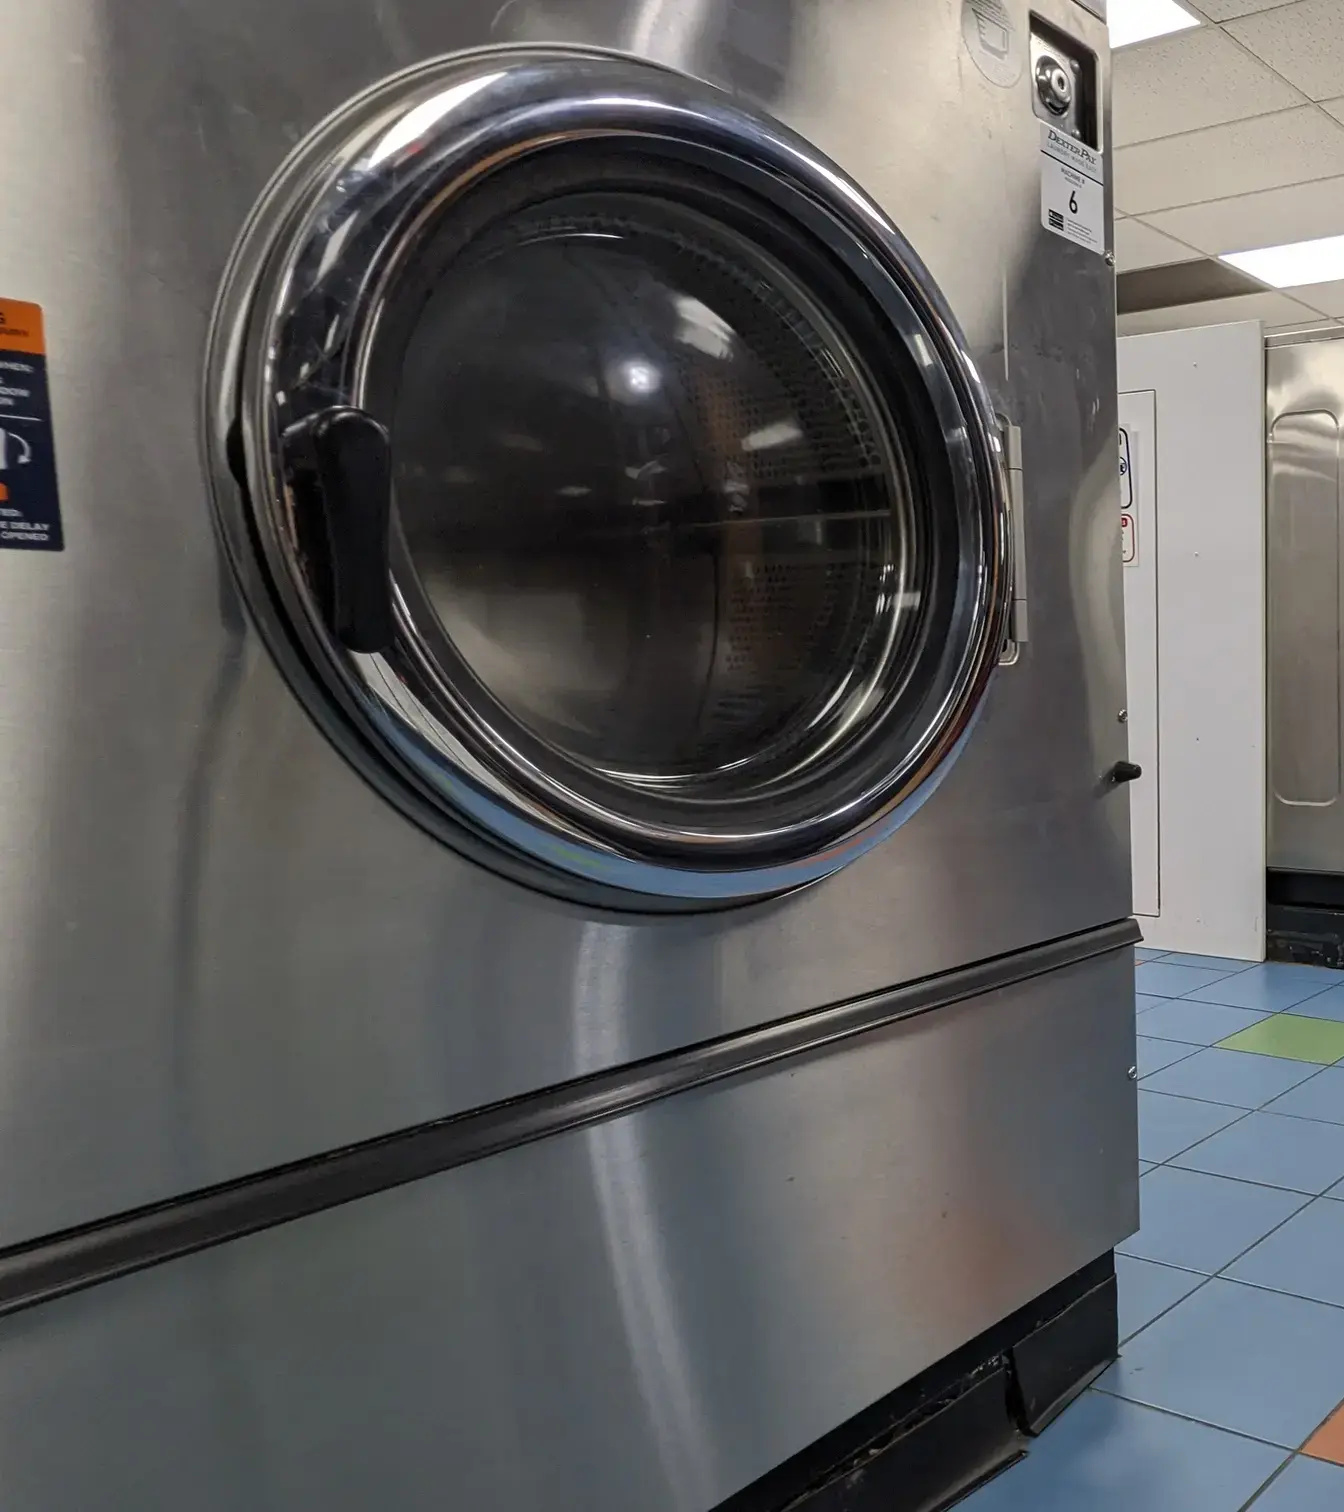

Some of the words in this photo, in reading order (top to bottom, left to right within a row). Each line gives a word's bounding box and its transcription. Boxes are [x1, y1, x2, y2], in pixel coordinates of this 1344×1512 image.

[1069, 190, 1078, 214] 6
[9, 521, 50, 531] DELAY
[0, 531, 50, 541] OPENED
